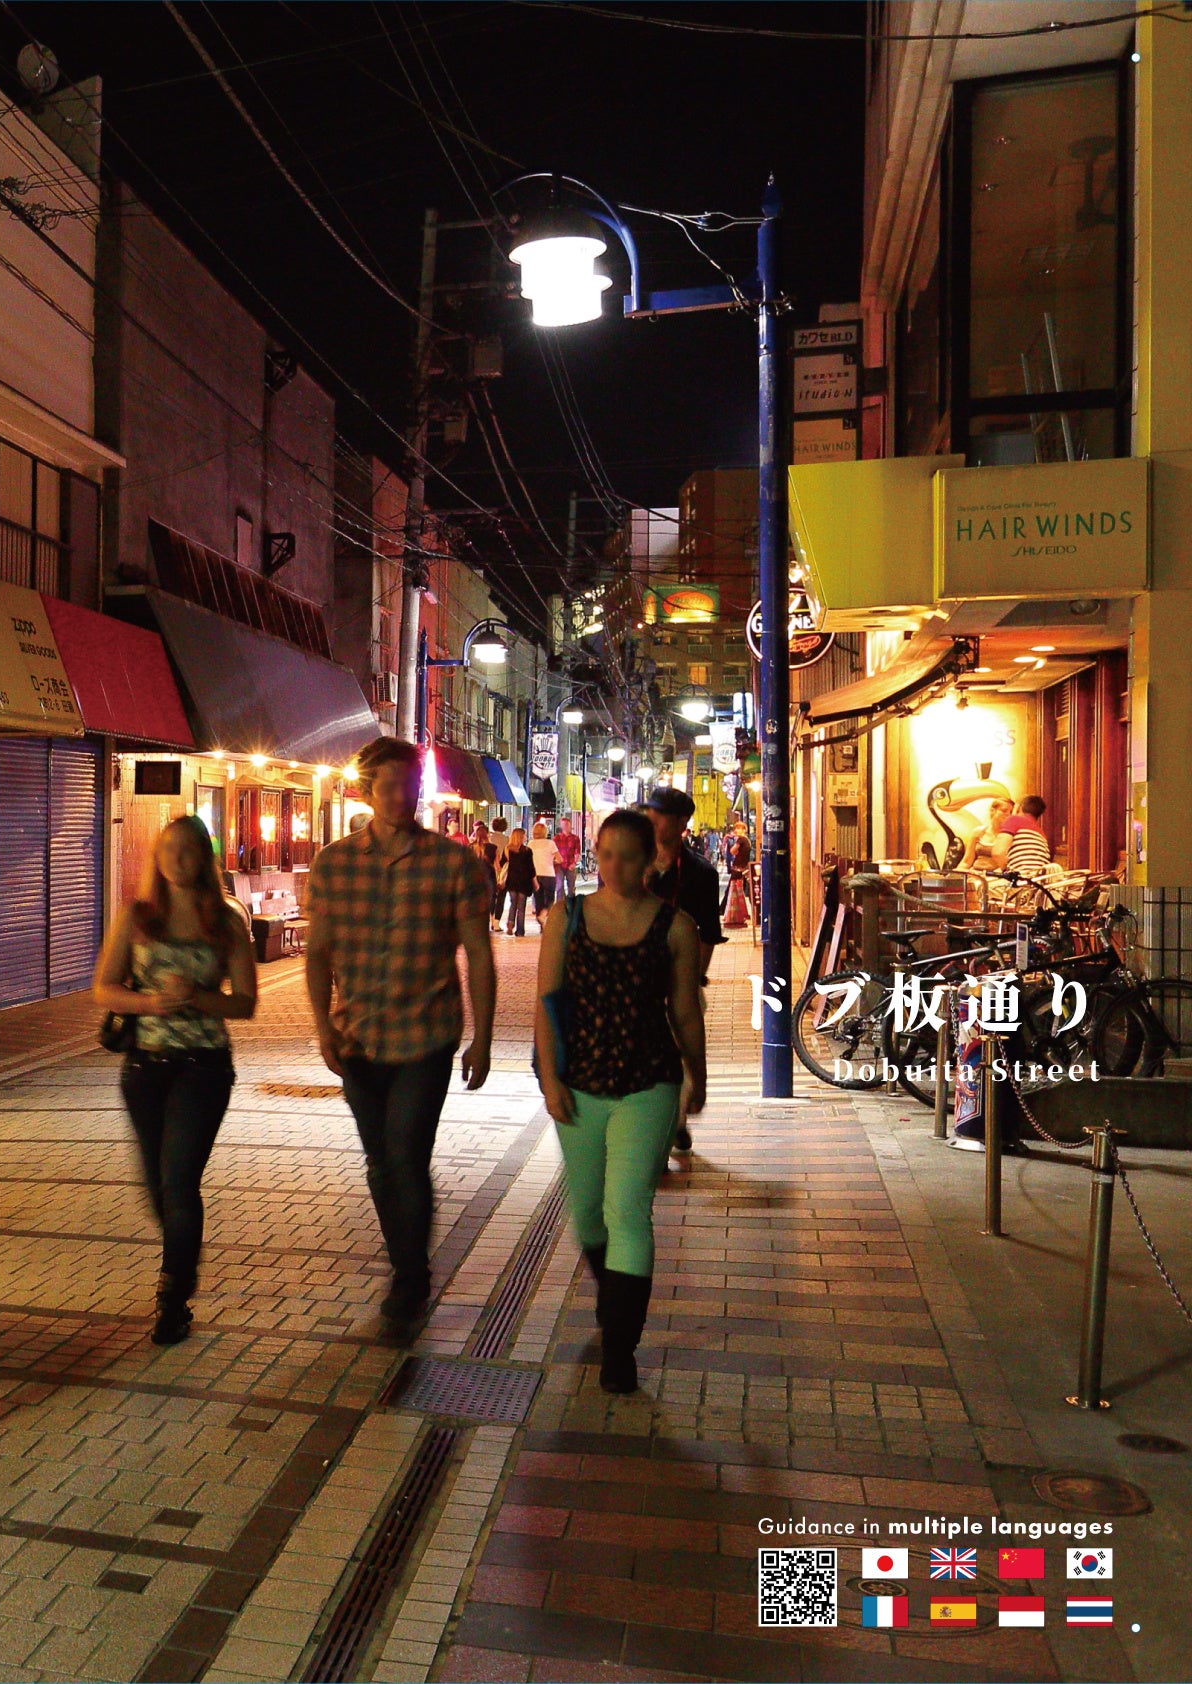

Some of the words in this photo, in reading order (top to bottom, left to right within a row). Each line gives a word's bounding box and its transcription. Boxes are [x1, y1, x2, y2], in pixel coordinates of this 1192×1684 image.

[957, 516, 1027, 541] HAIR
[1035, 510, 1133, 538] WINDS
[1010, 545, 1077, 558] SHISEIDO
[30, 674, 70, 698] ローズ商会
